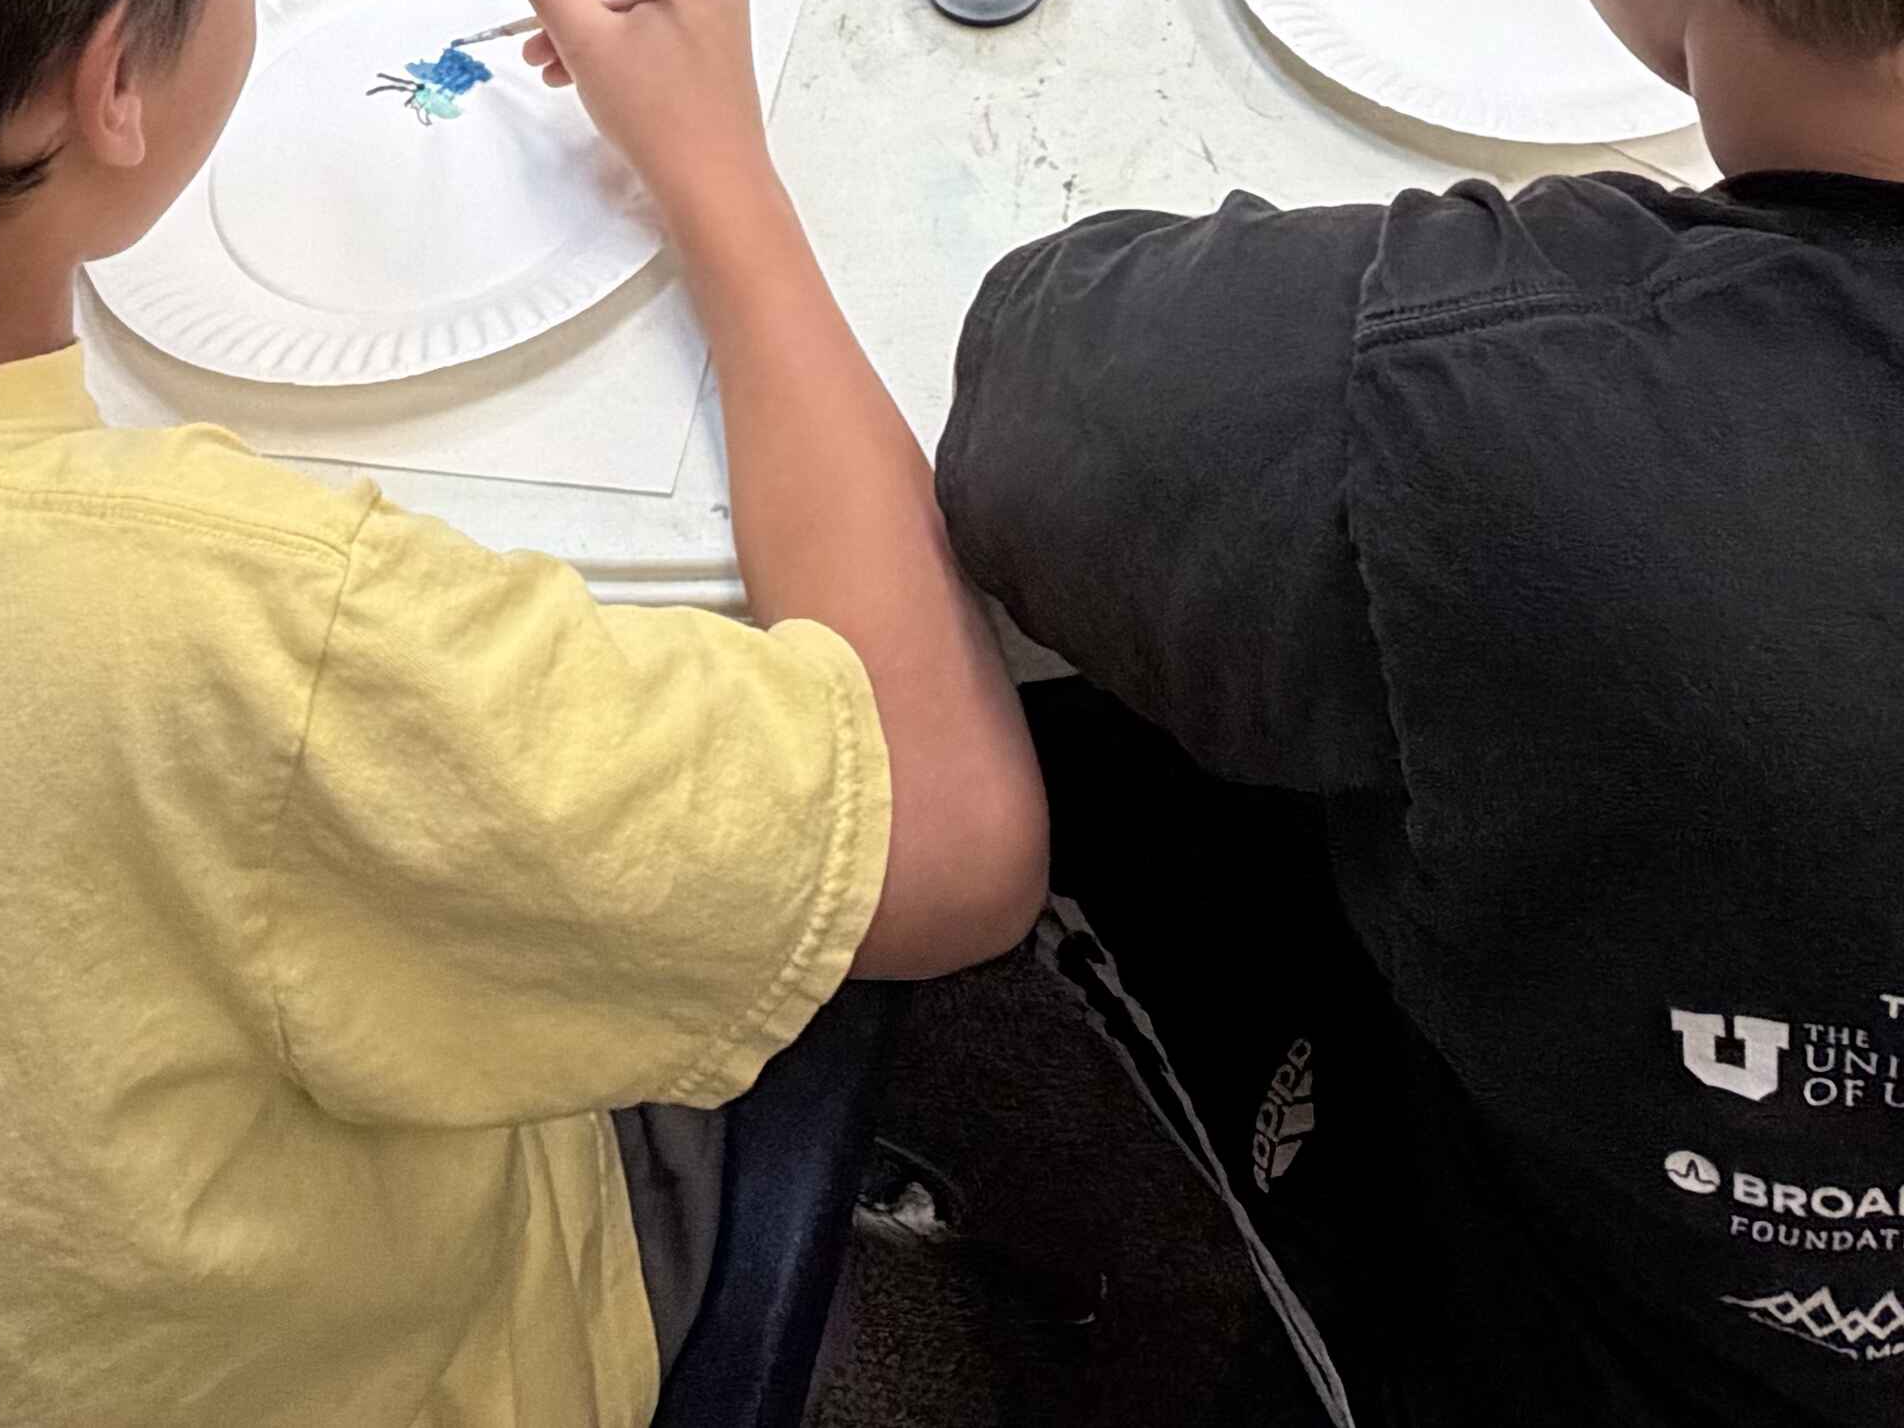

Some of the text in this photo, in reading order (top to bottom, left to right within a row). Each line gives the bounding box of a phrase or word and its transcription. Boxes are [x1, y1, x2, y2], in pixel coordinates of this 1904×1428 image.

[1803, 1022, 1871, 1049] THE
[1670, 1007, 1790, 1101] U
[1803, 1076, 1865, 1107] OF
